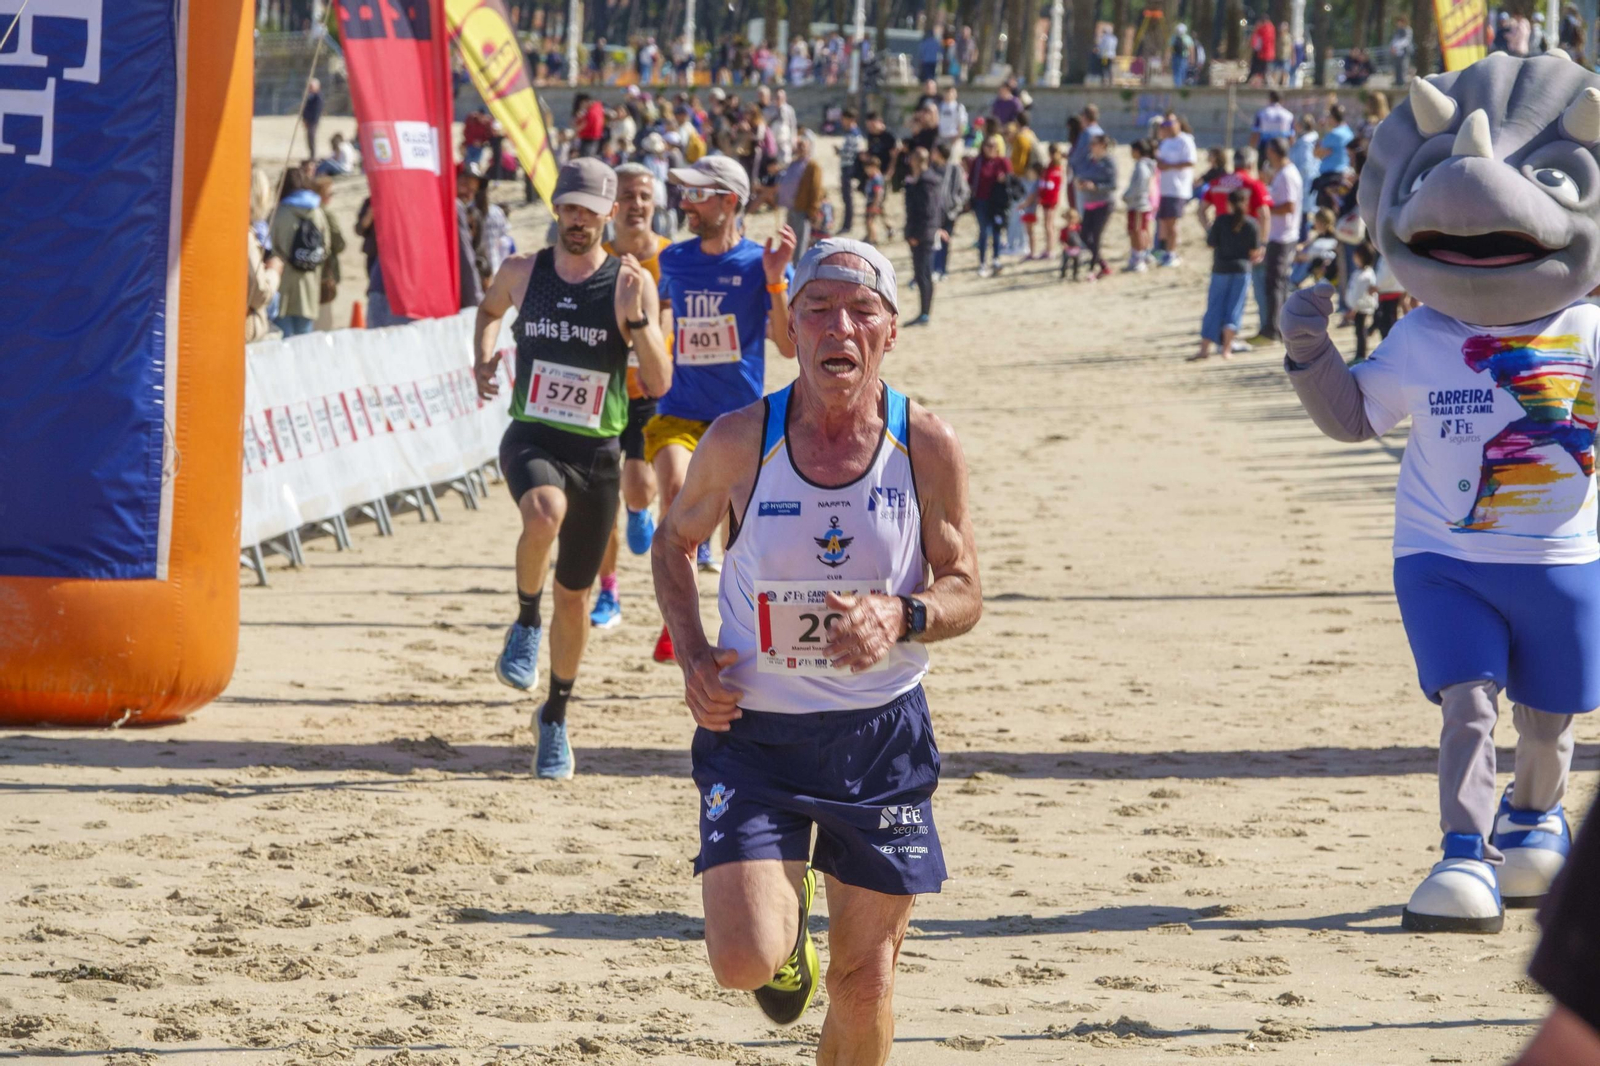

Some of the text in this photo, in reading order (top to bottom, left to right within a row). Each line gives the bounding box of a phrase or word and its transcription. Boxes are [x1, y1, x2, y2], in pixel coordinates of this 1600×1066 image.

[685, 293, 724, 317] 10K
[525, 317, 559, 338] máis
[571, 324, 608, 347] auga
[690, 332, 722, 348] 401
[546, 381, 588, 405] 578
[1429, 389, 1494, 406] CARREIRA
[1430, 405, 1494, 416] PRAIA DE SAMIL
[1449, 434, 1481, 445] seguros
[892, 825, 929, 837] seguros
